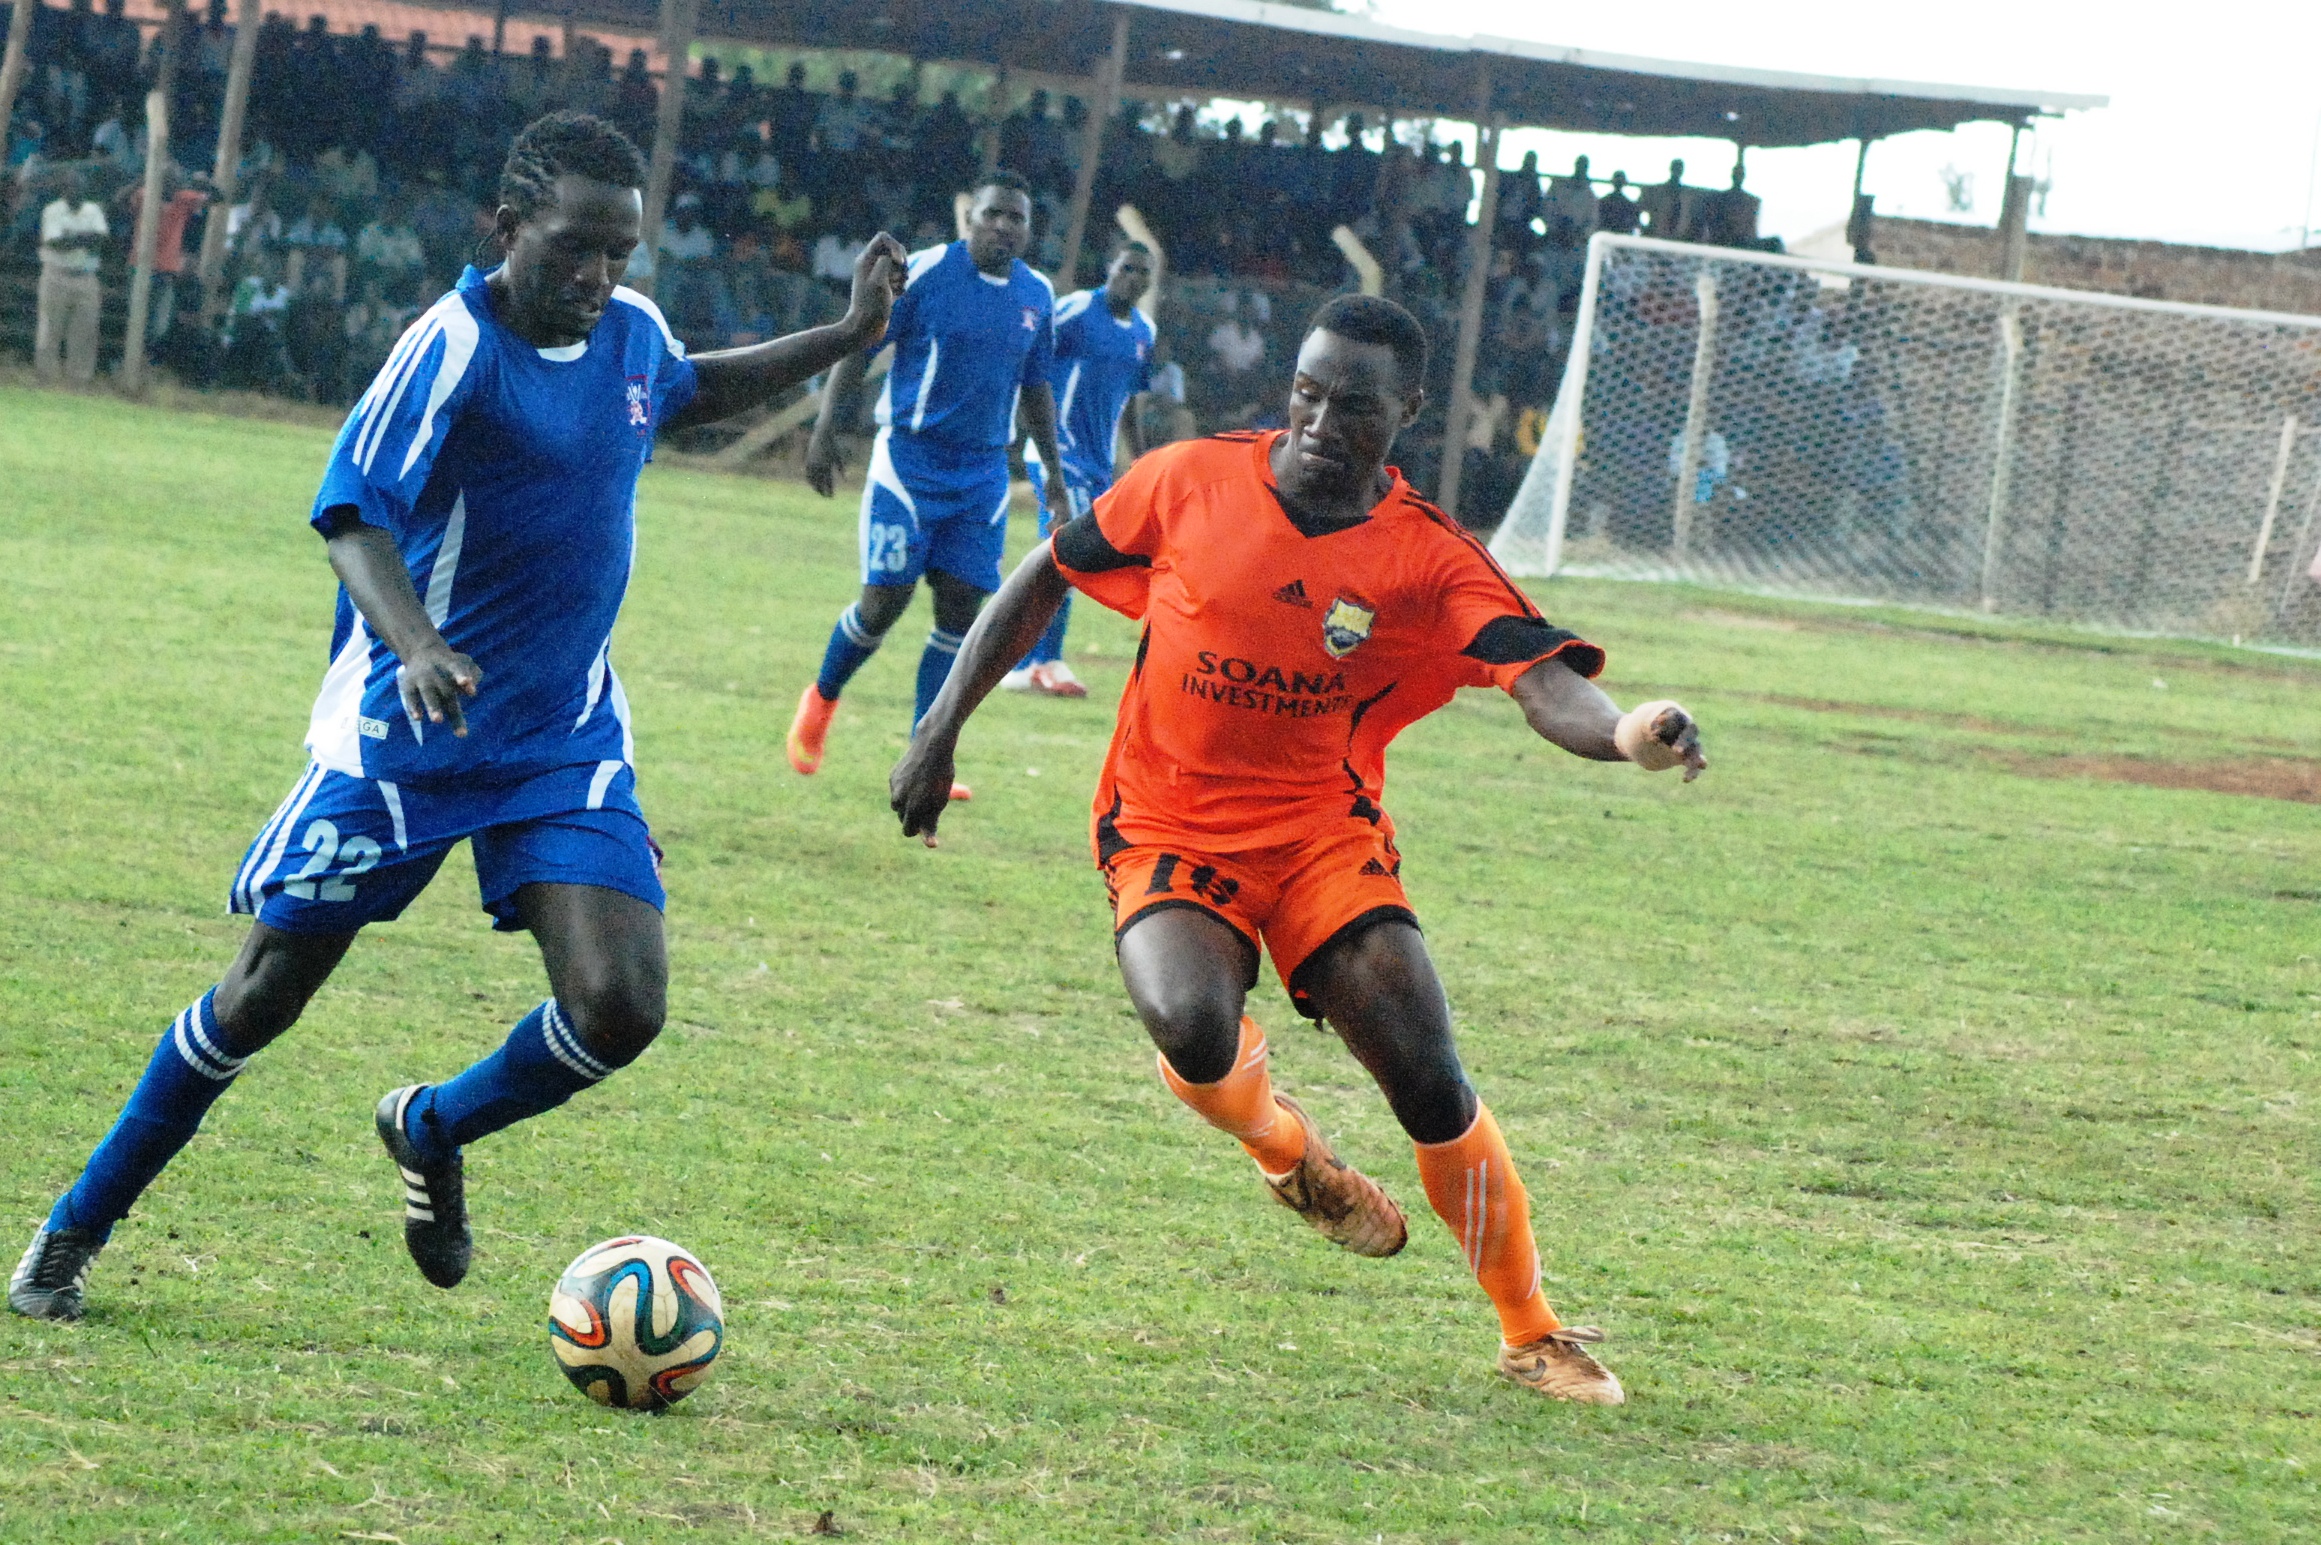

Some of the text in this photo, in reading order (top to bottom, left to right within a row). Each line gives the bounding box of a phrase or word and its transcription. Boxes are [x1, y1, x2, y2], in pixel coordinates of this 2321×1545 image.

[870, 522, 907, 571] 23
[1195, 650, 1346, 694] SOANA
[283, 818, 382, 901] 22
